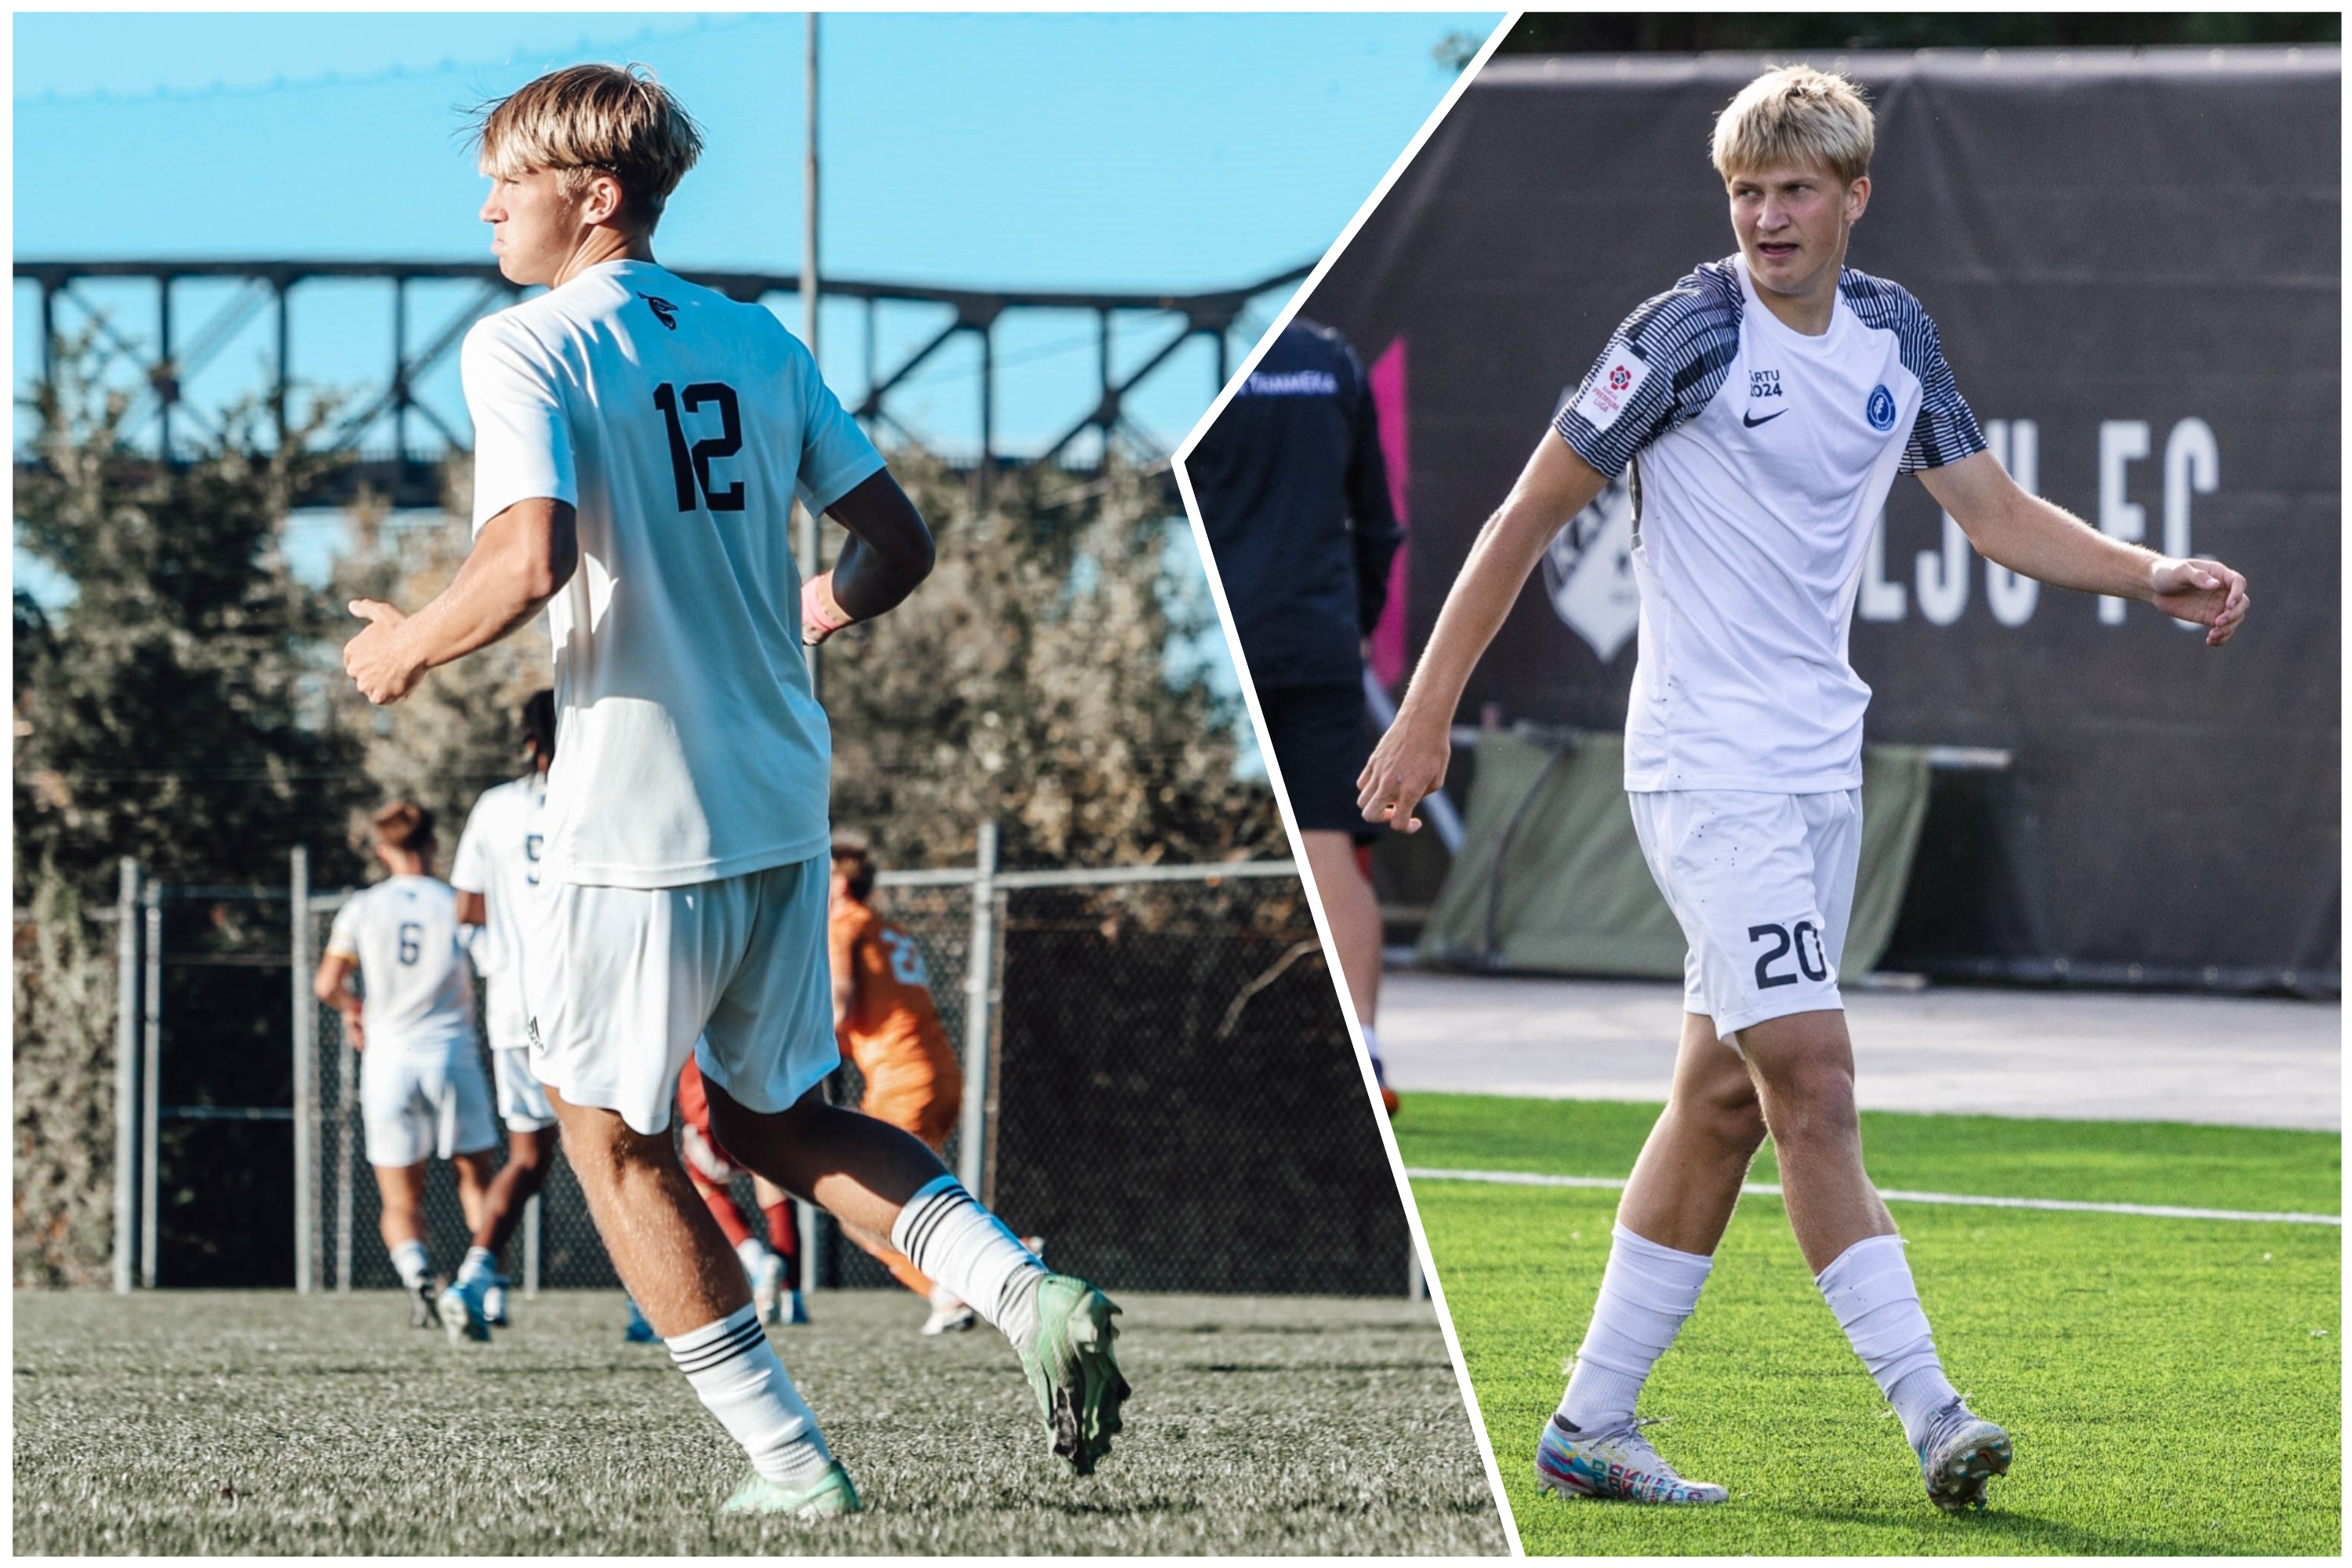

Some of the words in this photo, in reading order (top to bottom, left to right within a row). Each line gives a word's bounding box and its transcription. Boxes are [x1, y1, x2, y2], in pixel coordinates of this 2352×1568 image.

[652, 382, 745, 512] 12
[2099, 416, 2221, 630] FC
[397, 921, 423, 966] 6
[1748, 920, 1828, 990] 20
